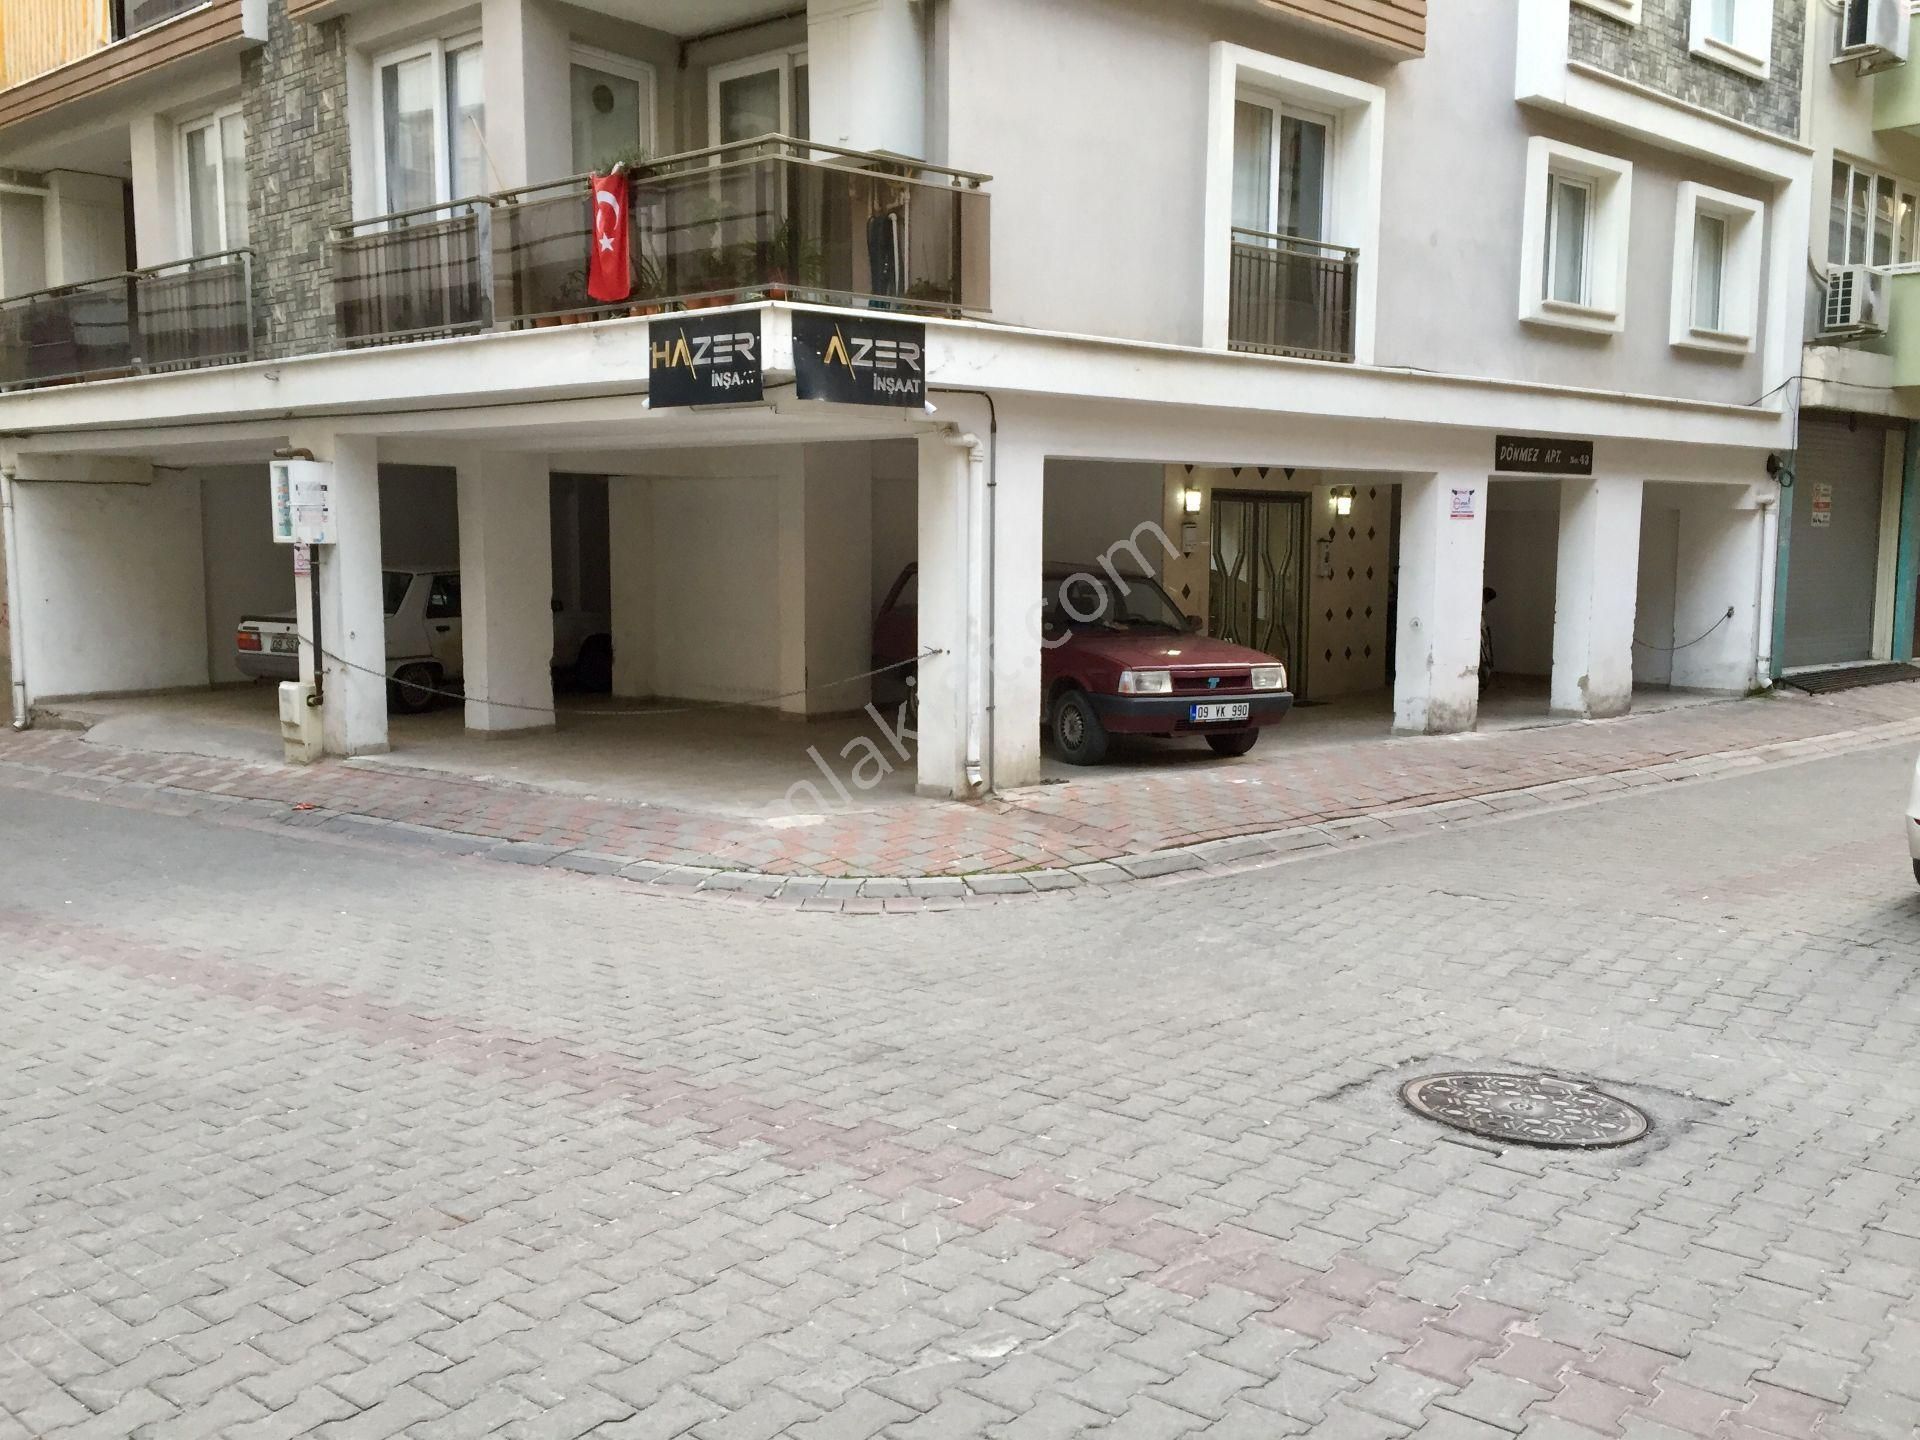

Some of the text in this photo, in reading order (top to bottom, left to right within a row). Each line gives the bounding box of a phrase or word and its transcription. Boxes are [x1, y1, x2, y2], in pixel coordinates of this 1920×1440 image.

[652, 328, 755, 379] HAZER
[711, 369, 756, 390] İNŞA
[873, 373, 921, 395] İNŞAAT
[1500, 444, 1540, 462] DÖNMEZ
[1198, 706, 1209, 718] 09
[1232, 705, 1247, 716] 990
